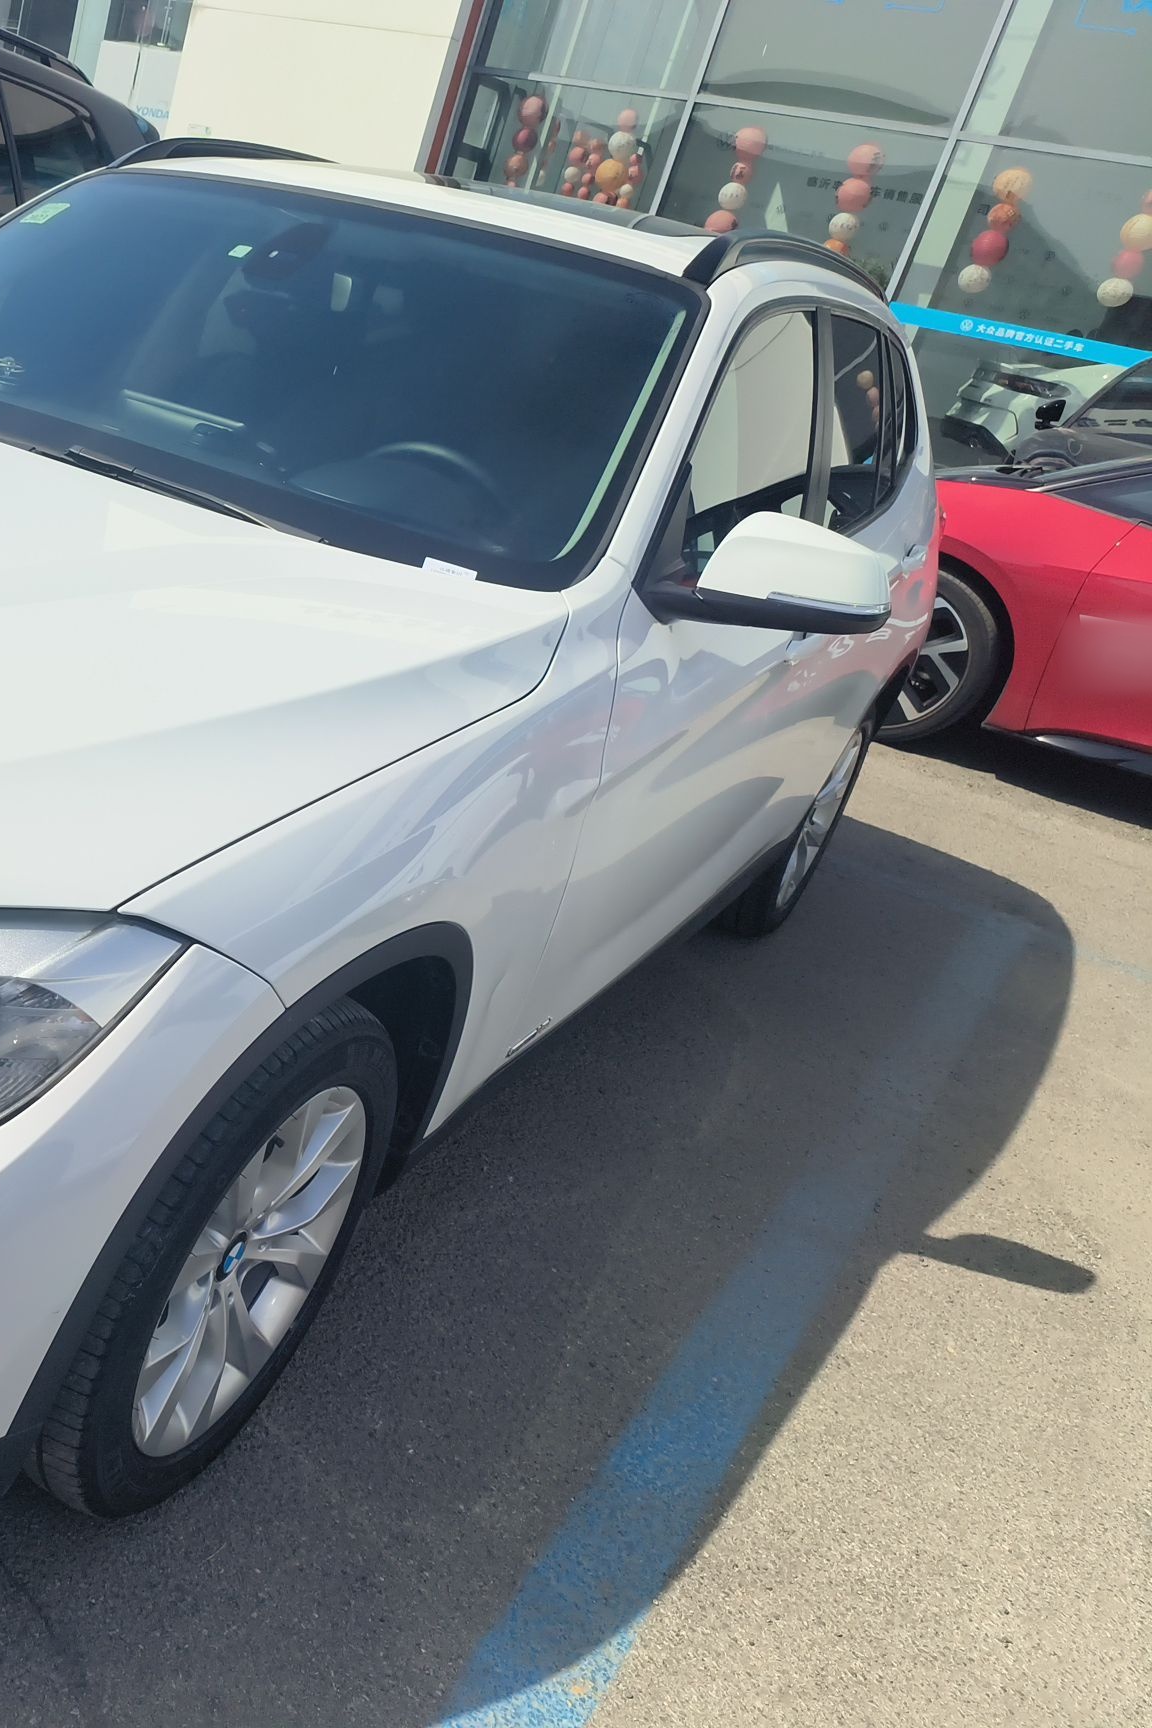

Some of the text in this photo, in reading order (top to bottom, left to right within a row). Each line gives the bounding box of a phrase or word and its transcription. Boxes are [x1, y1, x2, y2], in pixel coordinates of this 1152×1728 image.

[976, 323, 1085, 352] 大众品牌官方认证二手车
